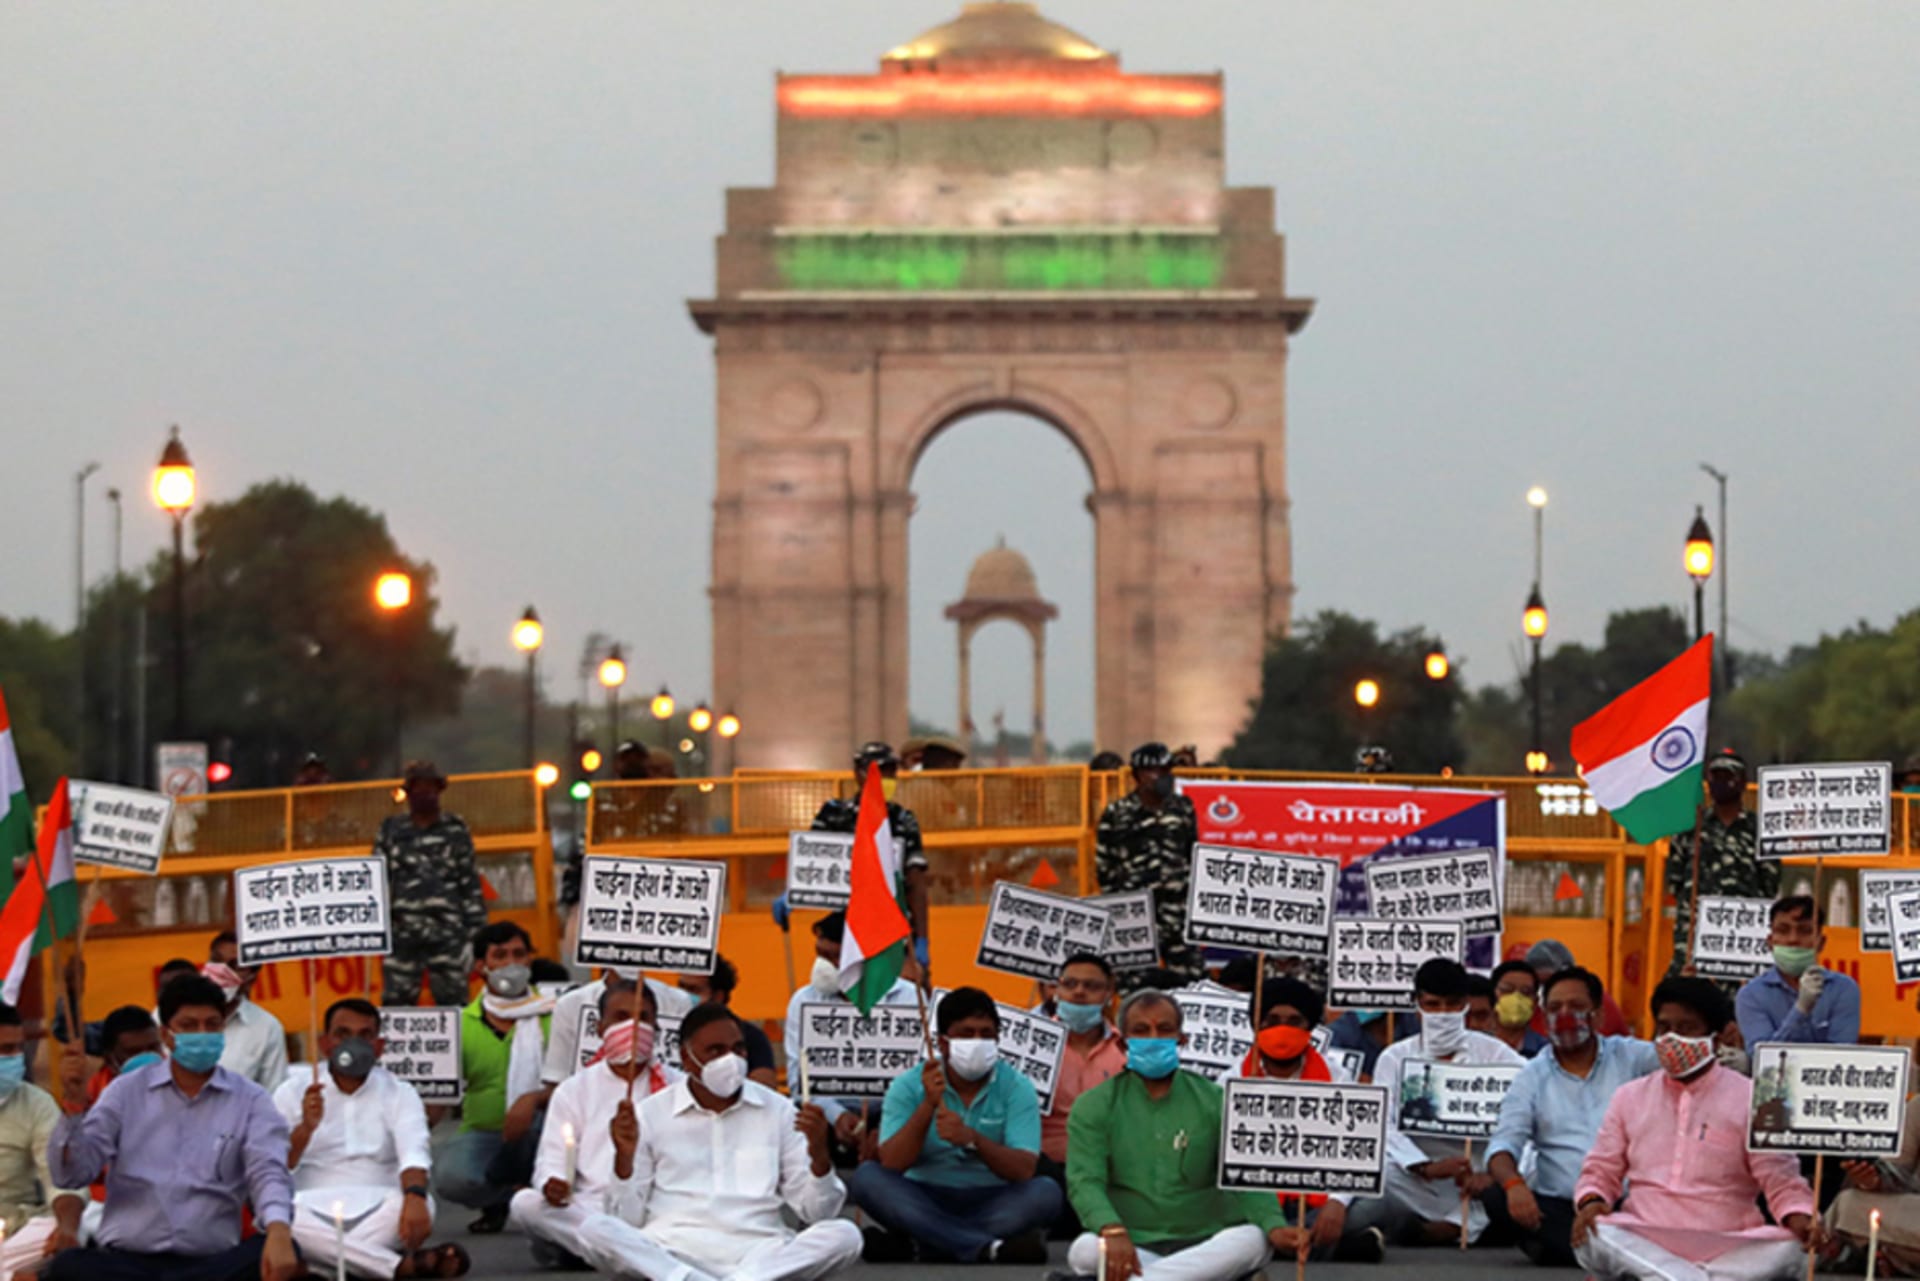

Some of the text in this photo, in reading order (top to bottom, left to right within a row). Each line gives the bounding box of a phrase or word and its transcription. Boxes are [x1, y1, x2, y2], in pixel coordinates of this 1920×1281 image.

[1287, 800, 1427, 826] चेतावनी
[248, 862, 372, 901] चाईना होश में आओ
[594, 863, 710, 900] चाईना होश में आओ
[1206, 853, 1325, 892] चाईना होश में आओ
[1373, 871, 1398, 891] भारत
[1400, 868, 1423, 888] माता
[1424, 866, 1442, 884] कर
[1444, 858, 1461, 886] रही
[1461, 860, 1489, 888] पुकार
[246, 895, 379, 933] भारत से मत टकराओ
[1198, 888, 1326, 926] भारत से मत टकराओ
[1376, 895, 1397, 918] चीन
[1398, 892, 1414, 917] को
[1432, 892, 1462, 913] करारा
[1463, 889, 1492, 909] जवाब
[1707, 901, 1733, 927] चाईना
[1736, 902, 1754, 929] होश
[588, 901, 710, 938] भारत से मत टकराओ
[1050, 906, 1063, 925] का
[1087, 915, 1105, 934] नाम
[992, 919, 1062, 958] चाईना की यही
[1338, 923, 1456, 954] आगे वार्ता पीछे प्रहार
[1701, 934, 1724, 952] भारत
[1726, 929, 1736, 952] से
[1737, 936, 1753, 954] मत
[1337, 954, 1356, 982] चीन
[1359, 962, 1373, 985] यह
[409, 1017, 437, 1032] 2020
[439, 1012, 447, 1034] है
[812, 1007, 849, 1040] चाईना
[881, 1009, 893, 1037] में
[1204, 1004, 1250, 1029] माता कर
[408, 1034, 422, 1054] को
[1012, 1018, 1059, 1055] रही पुकार
[1193, 1026, 1210, 1053] को
[417, 1061, 433, 1076] बार
[806, 1040, 918, 1069] भारत से मत टकरा
[1801, 1068, 1827, 1086] भारत
[1844, 1064, 1862, 1088] वीर
[1233, 1091, 1380, 1132] भारत माता कर रही पुकार
[1863, 1101, 1890, 1121] नमन
[1231, 1122, 1377, 1160] चीन को देंगे करारा जवाब
